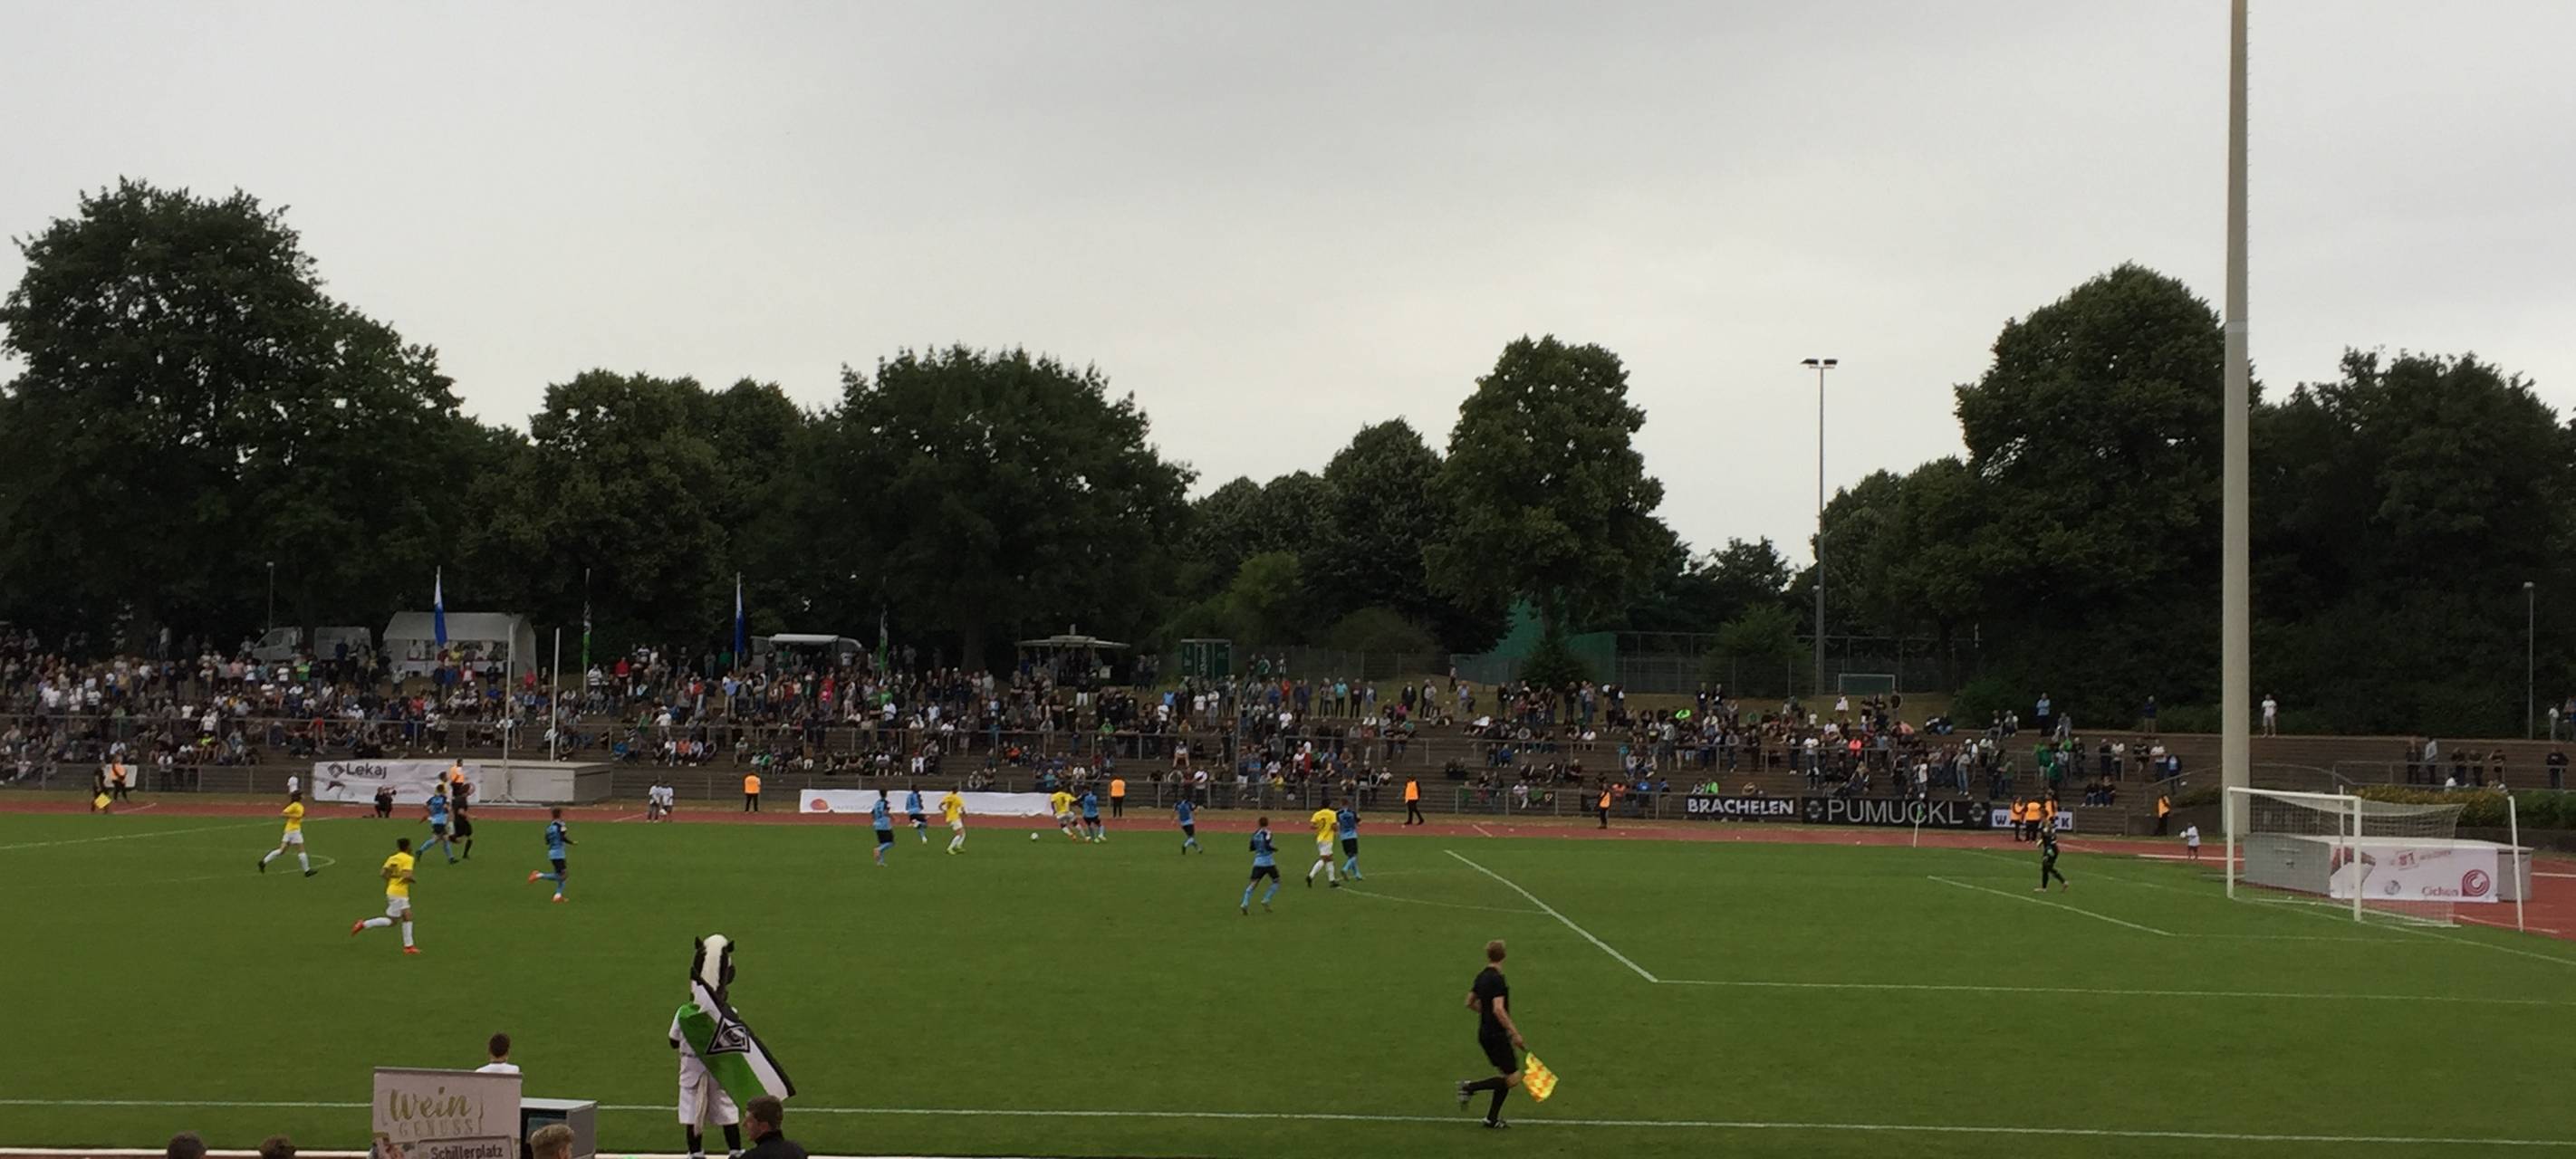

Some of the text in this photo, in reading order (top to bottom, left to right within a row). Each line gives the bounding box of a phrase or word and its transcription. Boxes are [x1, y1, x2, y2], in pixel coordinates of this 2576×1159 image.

[346, 762, 388, 779] Lekaj
[1687, 799, 1794, 815] BRACHELEN
[1827, 800, 1964, 825] PUMUCKL
[389, 1086, 472, 1122] Wein
[399, 1117, 474, 1136] GENUSS
[430, 1144, 504, 1159] Schillerplatz
